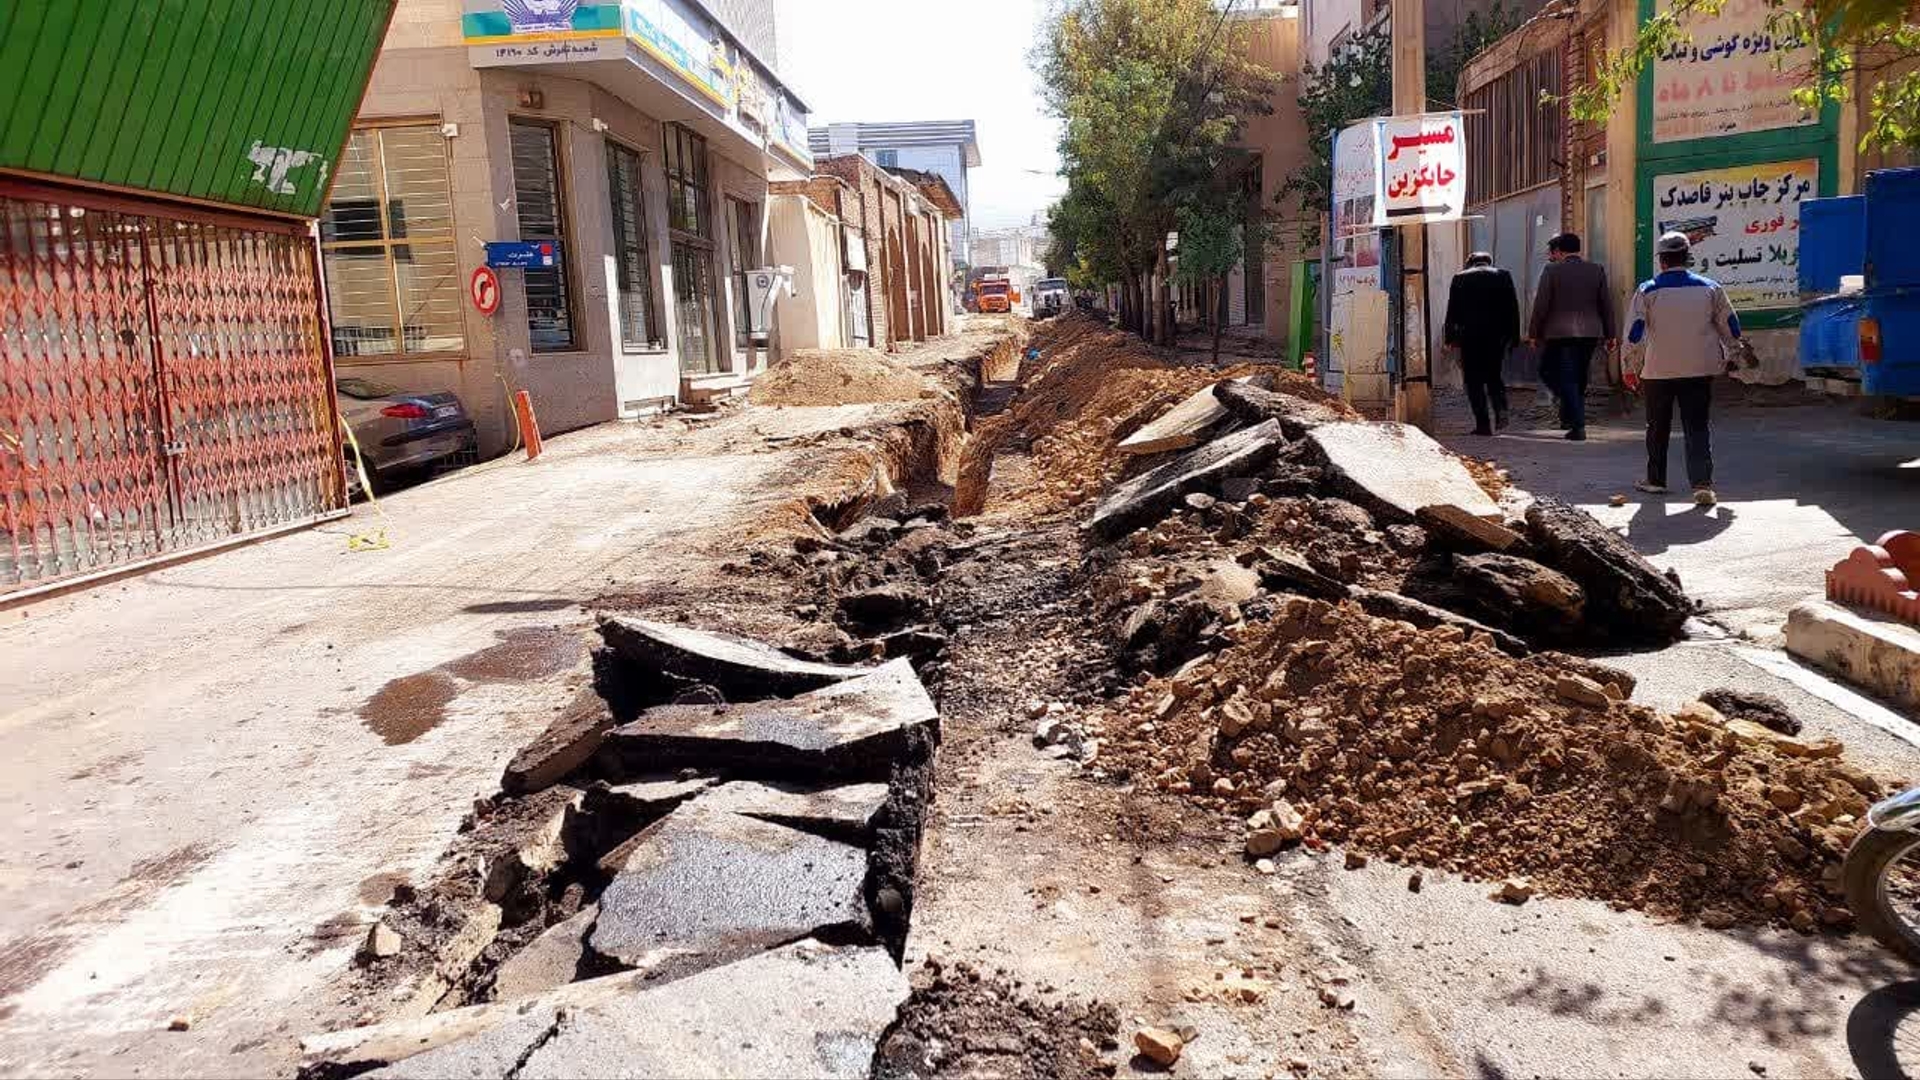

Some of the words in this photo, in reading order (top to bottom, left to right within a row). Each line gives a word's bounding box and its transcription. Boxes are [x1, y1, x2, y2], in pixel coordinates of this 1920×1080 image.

[1387, 125, 1455, 161] مسیر
[1660, 181, 1712, 209] قاصدک
[1714, 184, 1734, 210] بنر
[1738, 177, 1770, 208] چاپ
[1776, 173, 1811, 204] مرکز
[1745, 213, 1785, 235] فوری
[1700, 256, 1709, 273] و
[1715, 246, 1763, 270] تسلیت
[1769, 243, 1800, 267] ربلا
